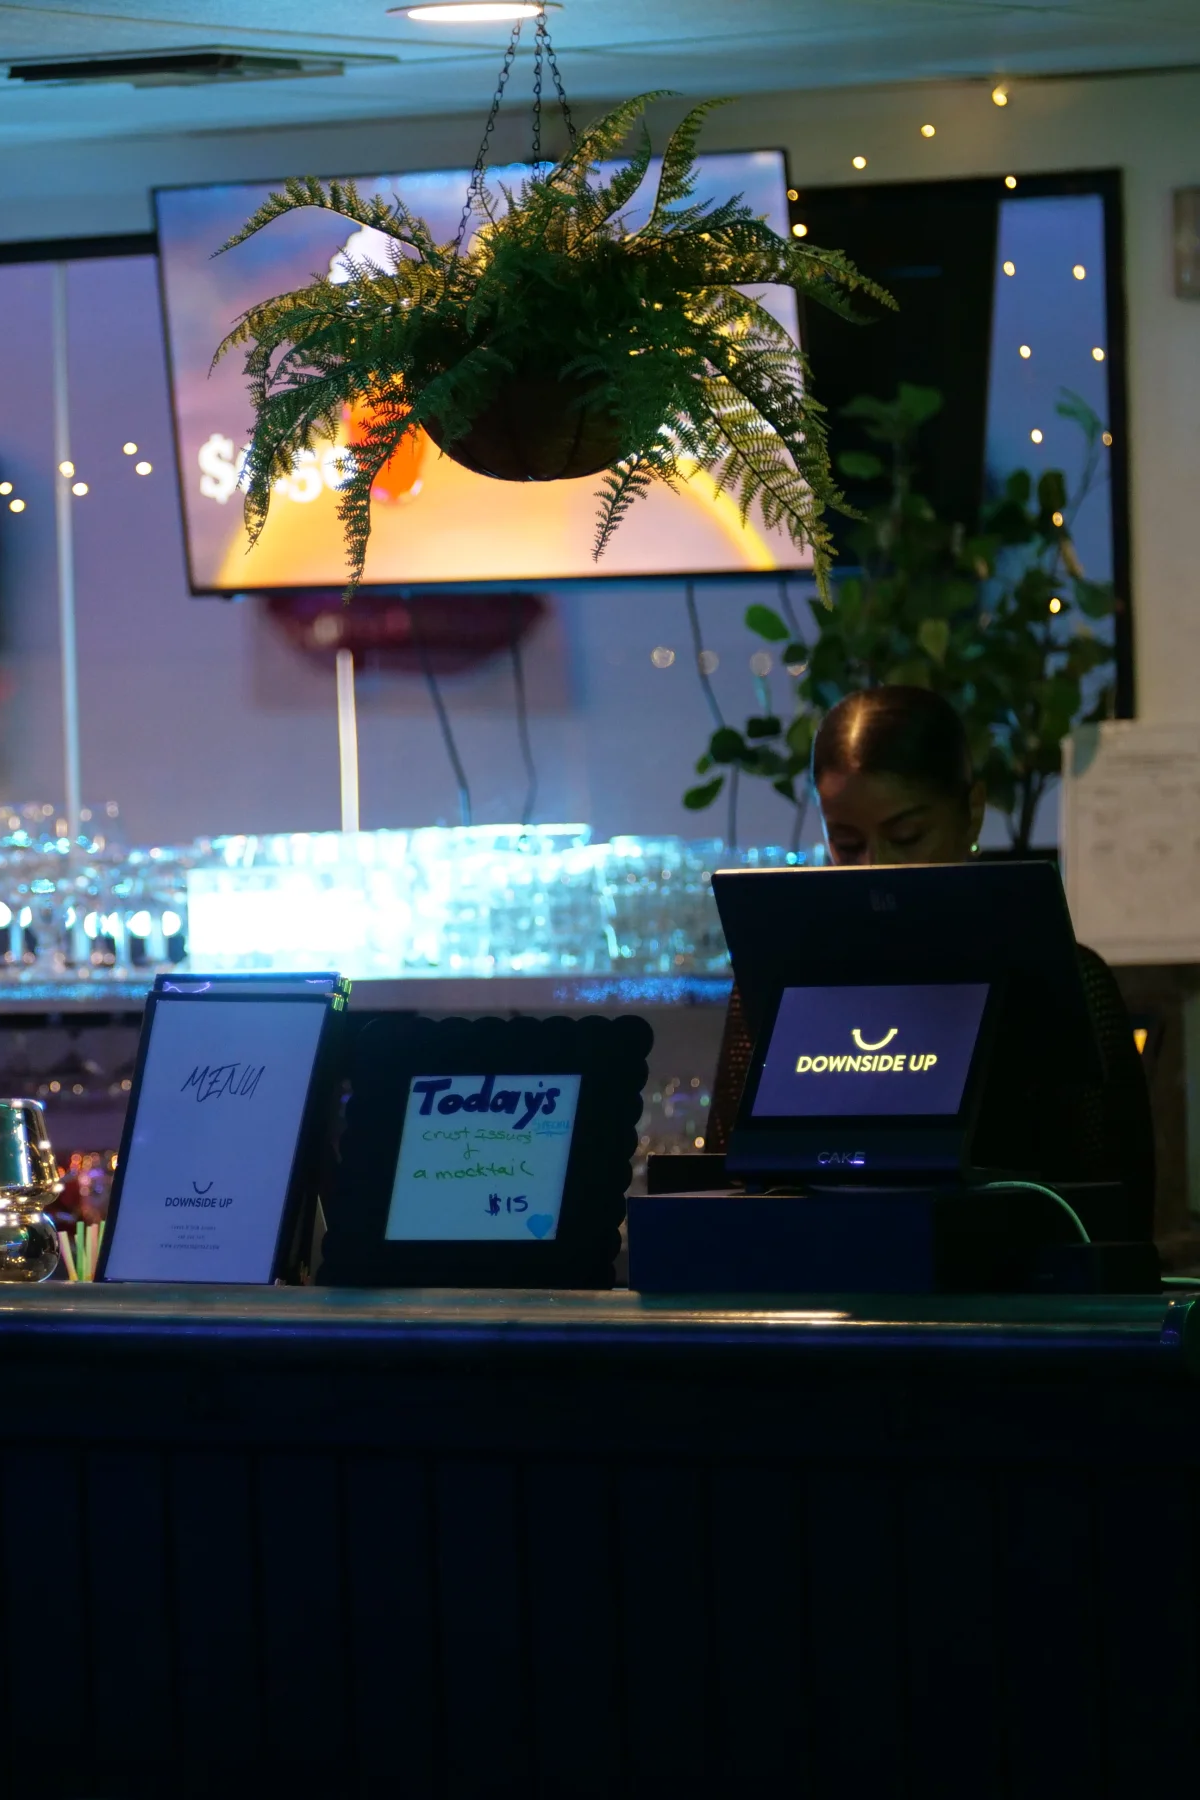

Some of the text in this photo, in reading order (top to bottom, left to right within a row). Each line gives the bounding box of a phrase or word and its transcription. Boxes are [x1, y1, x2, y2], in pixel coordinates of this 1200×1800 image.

[198, 433, 359, 505] $.50
[796, 1054, 937, 1073] DOWNSIDE UP
[180, 1063, 266, 1103] MENU
[412, 1076, 561, 1130] Today's
[817, 1151, 866, 1165] CAKE
[413, 1169, 427, 1179] a
[165, 1197, 233, 1208] DOWNSIDE UP
[484, 1193, 529, 1216] $15
